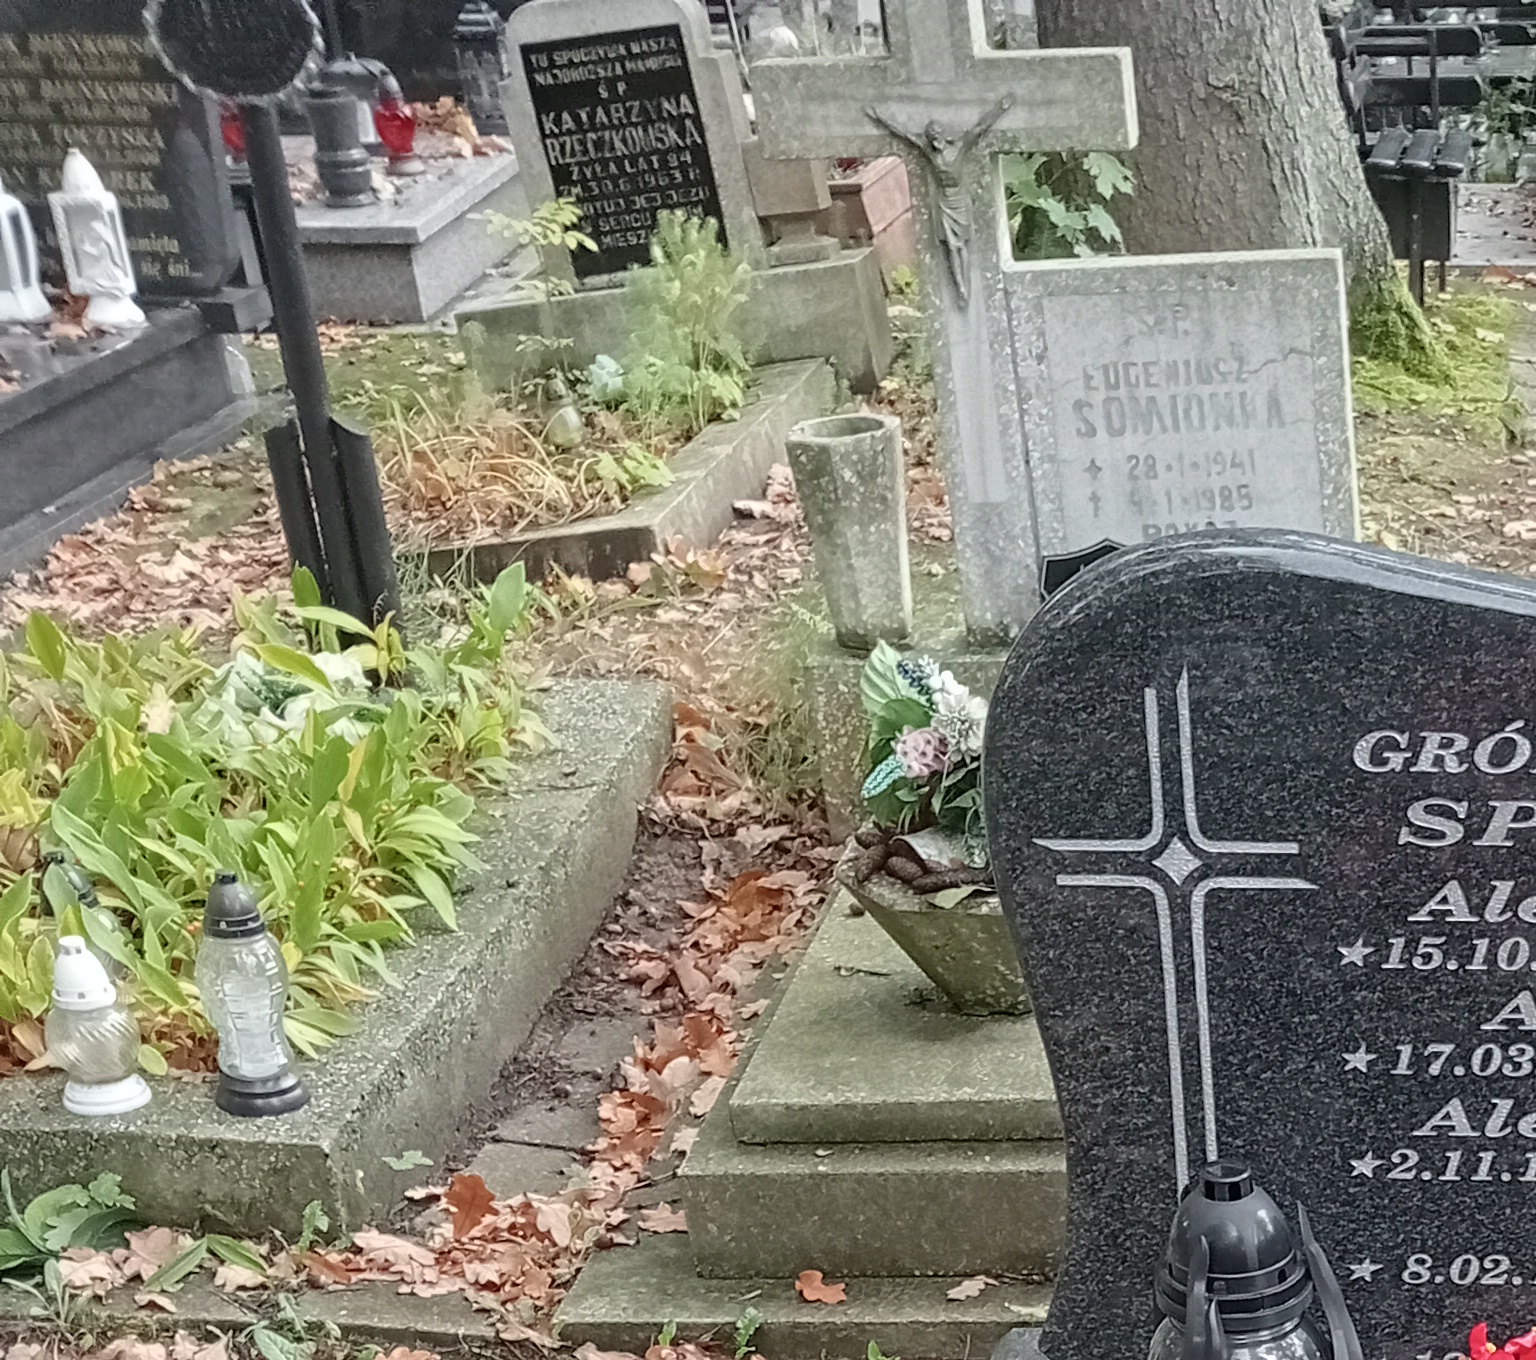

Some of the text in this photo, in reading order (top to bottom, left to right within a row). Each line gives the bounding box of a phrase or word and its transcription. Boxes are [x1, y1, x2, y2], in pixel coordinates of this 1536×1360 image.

[540, 93, 696, 135] KATARZYNA
[545, 117, 704, 167] RZECZKOWSKA
[623, 154, 660, 174] LAT
[1083, 355, 1249, 392] EUGENIUSZ
[1071, 387, 1286, 440] SOMIONKA
